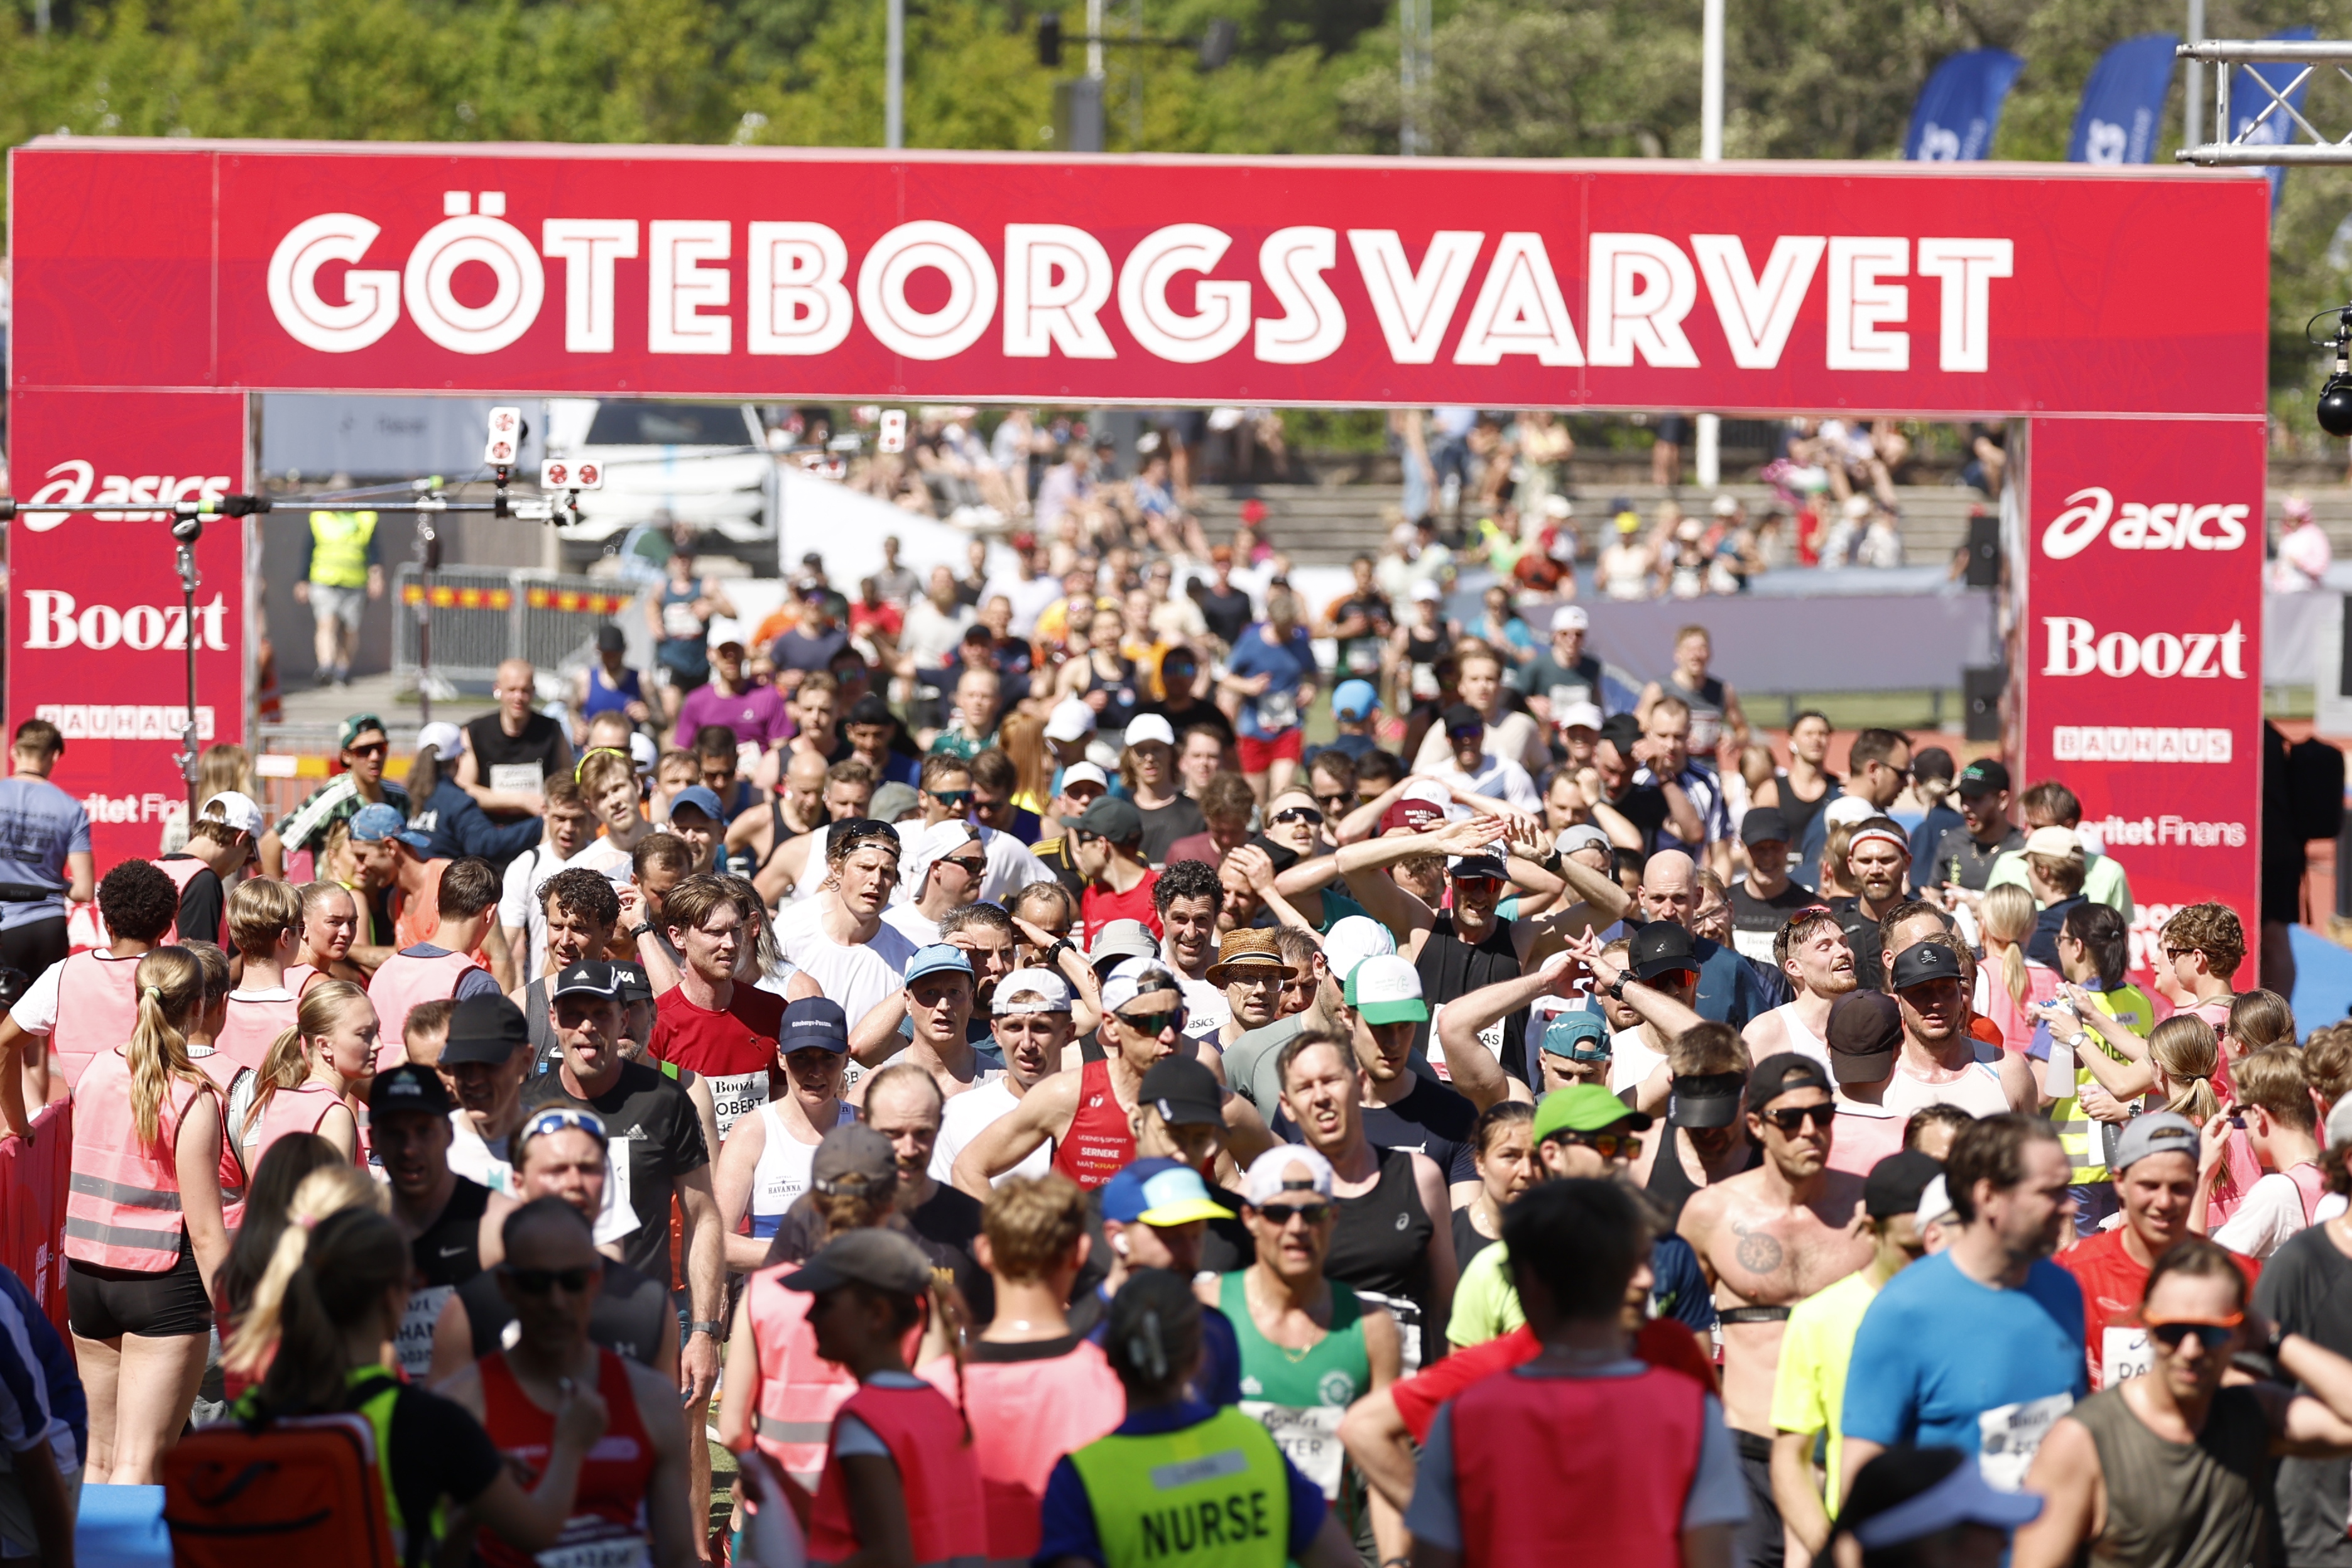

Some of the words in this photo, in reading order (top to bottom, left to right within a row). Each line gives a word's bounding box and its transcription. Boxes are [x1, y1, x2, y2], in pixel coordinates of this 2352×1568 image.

[265, 190, 2015, 373] GÖTEBORGSVARVET
[2108, 503, 2250, 550] asics
[23, 590, 229, 651] Boozt
[2042, 616, 2246, 679] Boozt
[2057, 731, 2231, 756] BAUHAUS
[82, 792, 139, 823] ritet
[2157, 815, 2247, 847] Finans
[1189, 1018, 1214, 1028] asics
[715, 1080, 754, 1094] Boozt
[716, 1097, 763, 1116] OBERT
[1081, 1146, 1119, 1158] SERNEKE
[768, 1184, 802, 1194] HAVANNA
[1141, 1490, 1268, 1560] NURSE
